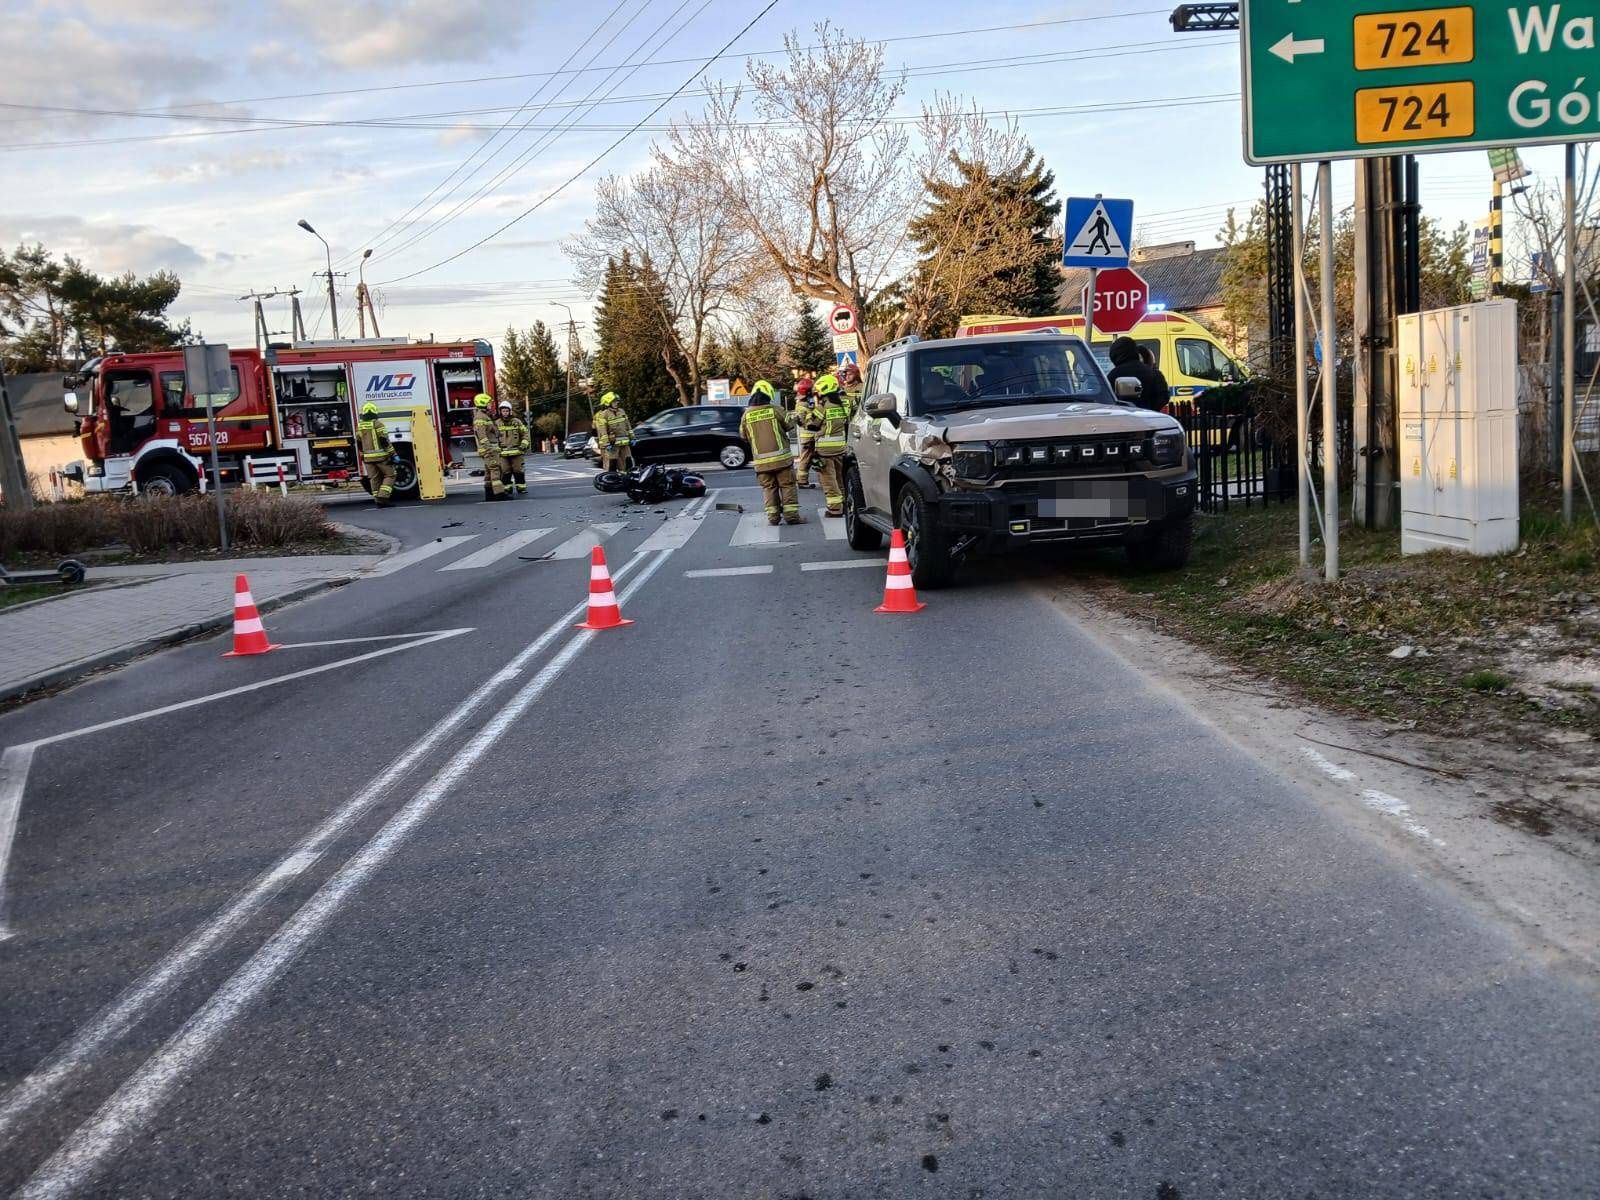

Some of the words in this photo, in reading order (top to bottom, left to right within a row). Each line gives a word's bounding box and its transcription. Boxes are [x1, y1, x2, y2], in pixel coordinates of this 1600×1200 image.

[1377, 19, 1450, 58] 724
[1379, 92, 1450, 132] 724
[1508, 77, 1600, 128] Gó
[1093, 290, 1142, 312] STOP
[189, 431, 229, 446] 56728
[1008, 445, 1142, 460] JETOUR
